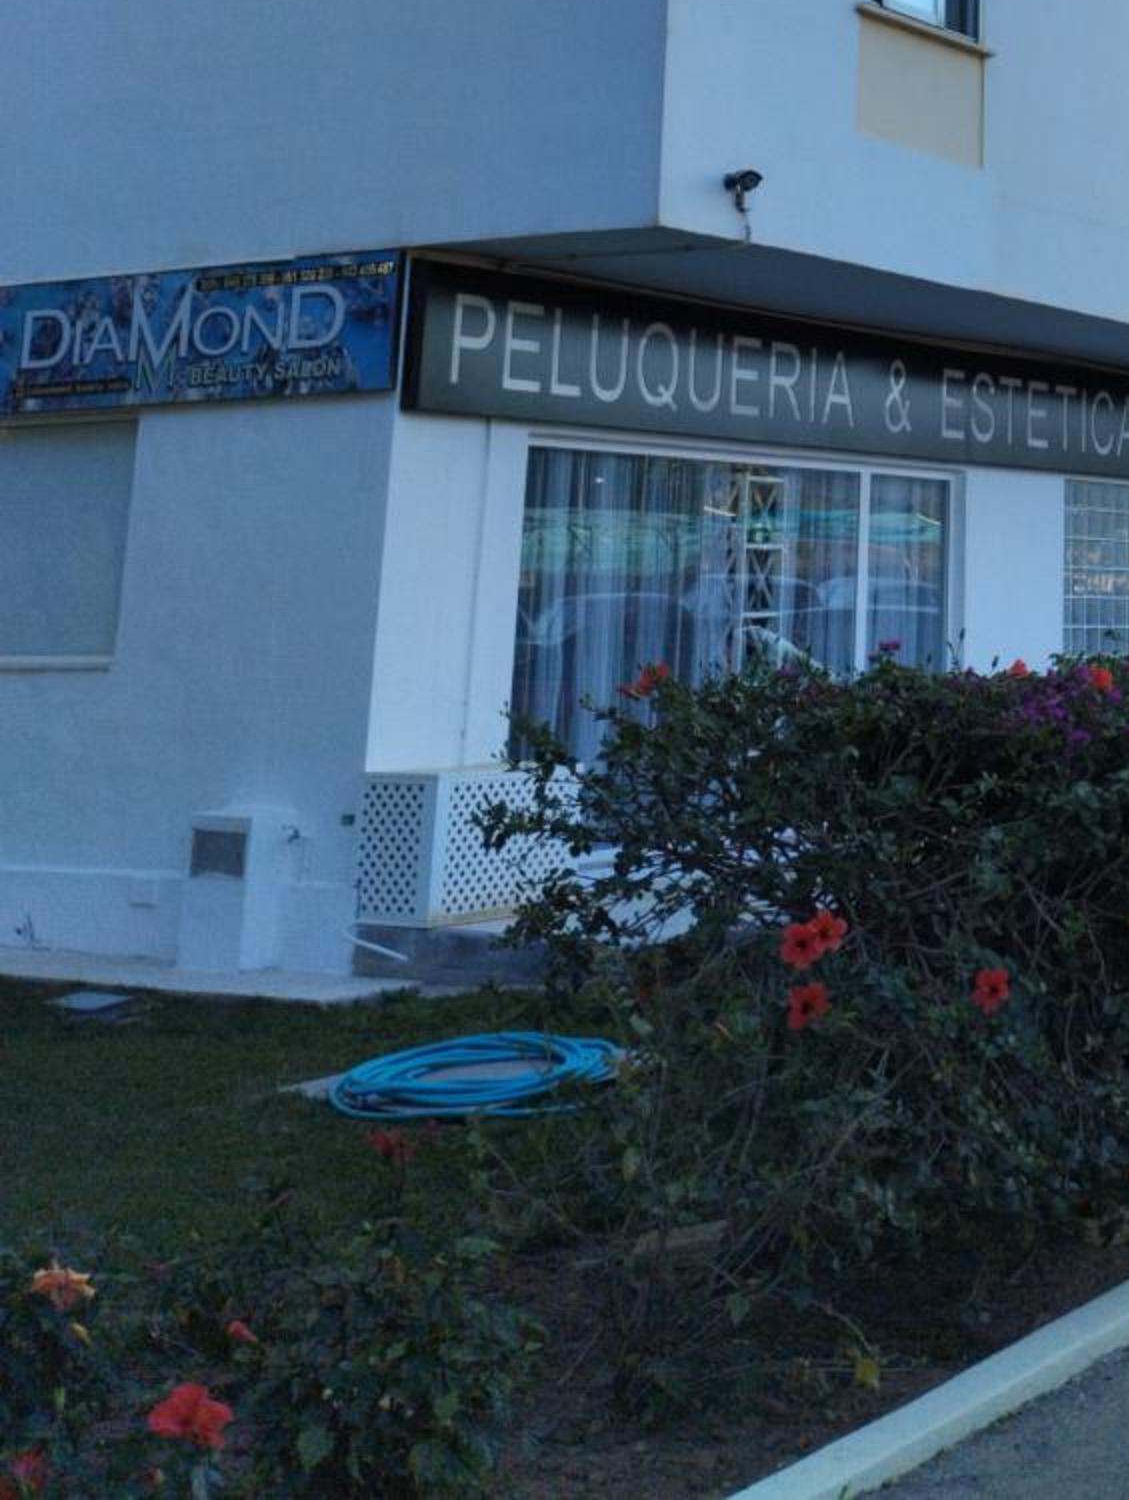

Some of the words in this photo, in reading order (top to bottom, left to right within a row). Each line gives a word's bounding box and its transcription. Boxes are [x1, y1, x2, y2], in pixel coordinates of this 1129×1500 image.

[190, 361, 269, 387] BEAUTY
[448, 292, 856, 430] PELUQUERIA
[883, 357, 913, 435] &
